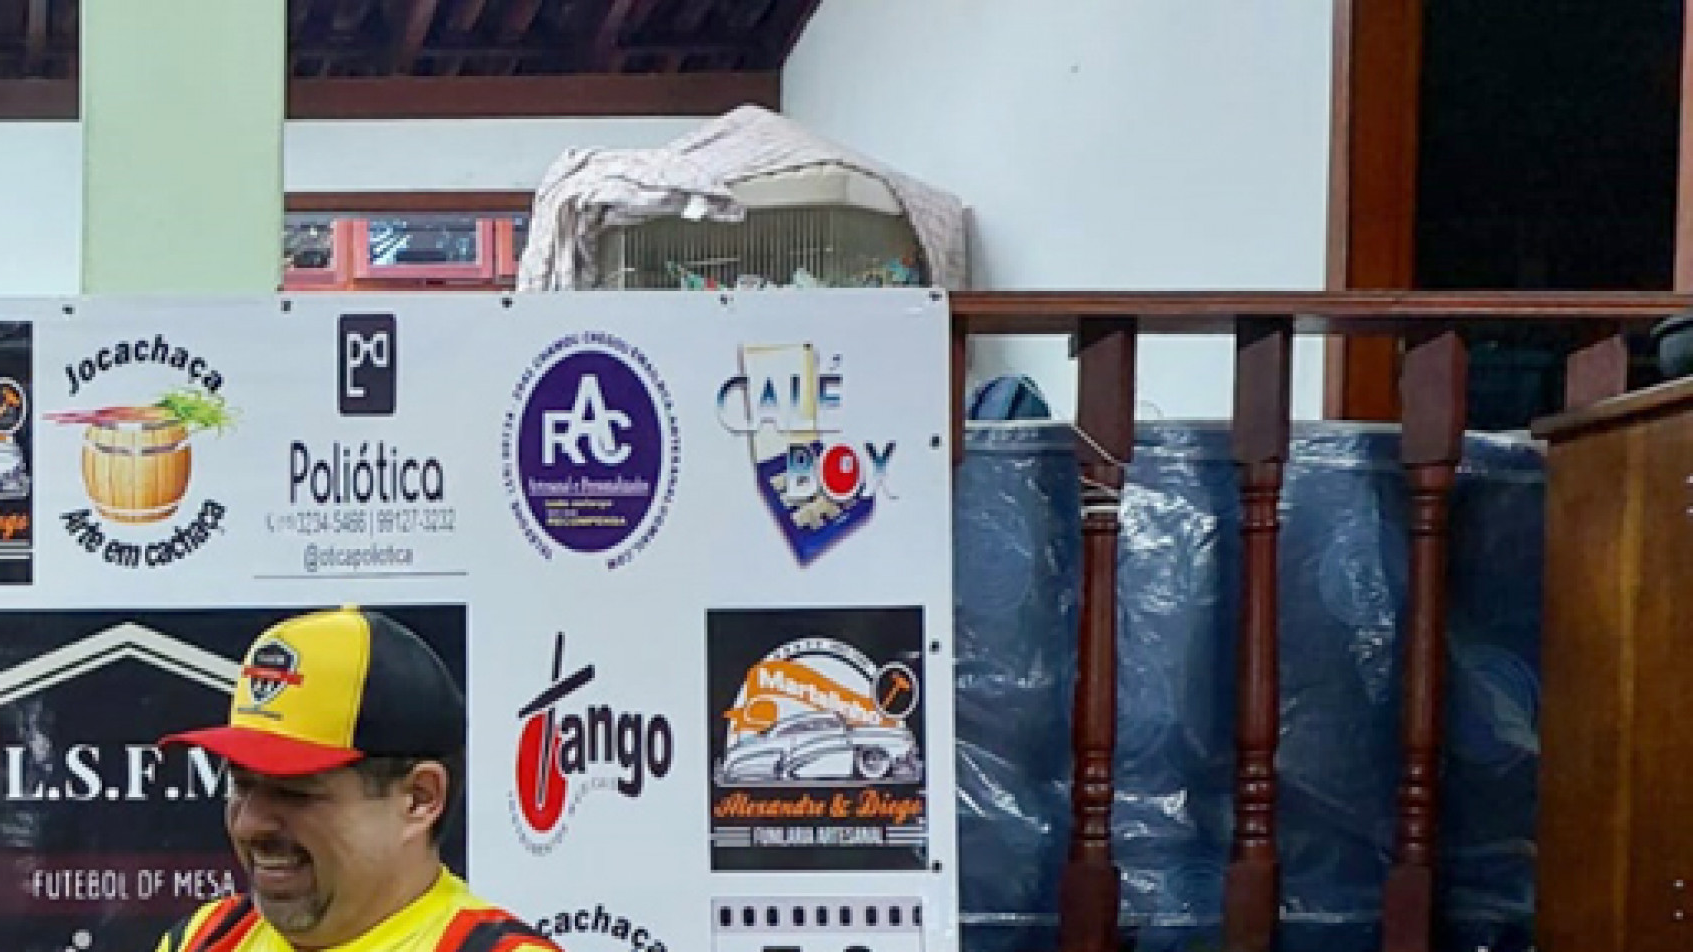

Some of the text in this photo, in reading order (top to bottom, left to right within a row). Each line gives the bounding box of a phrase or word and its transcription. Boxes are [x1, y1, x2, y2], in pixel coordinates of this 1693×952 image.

[64, 334, 224, 396] Jocachaça
[289, 438, 444, 503] Poliótica
[59, 499, 226, 569] Arte em cachaça
[33, 869, 131, 900] FUTEBOL
[173, 869, 237, 899] MESA
